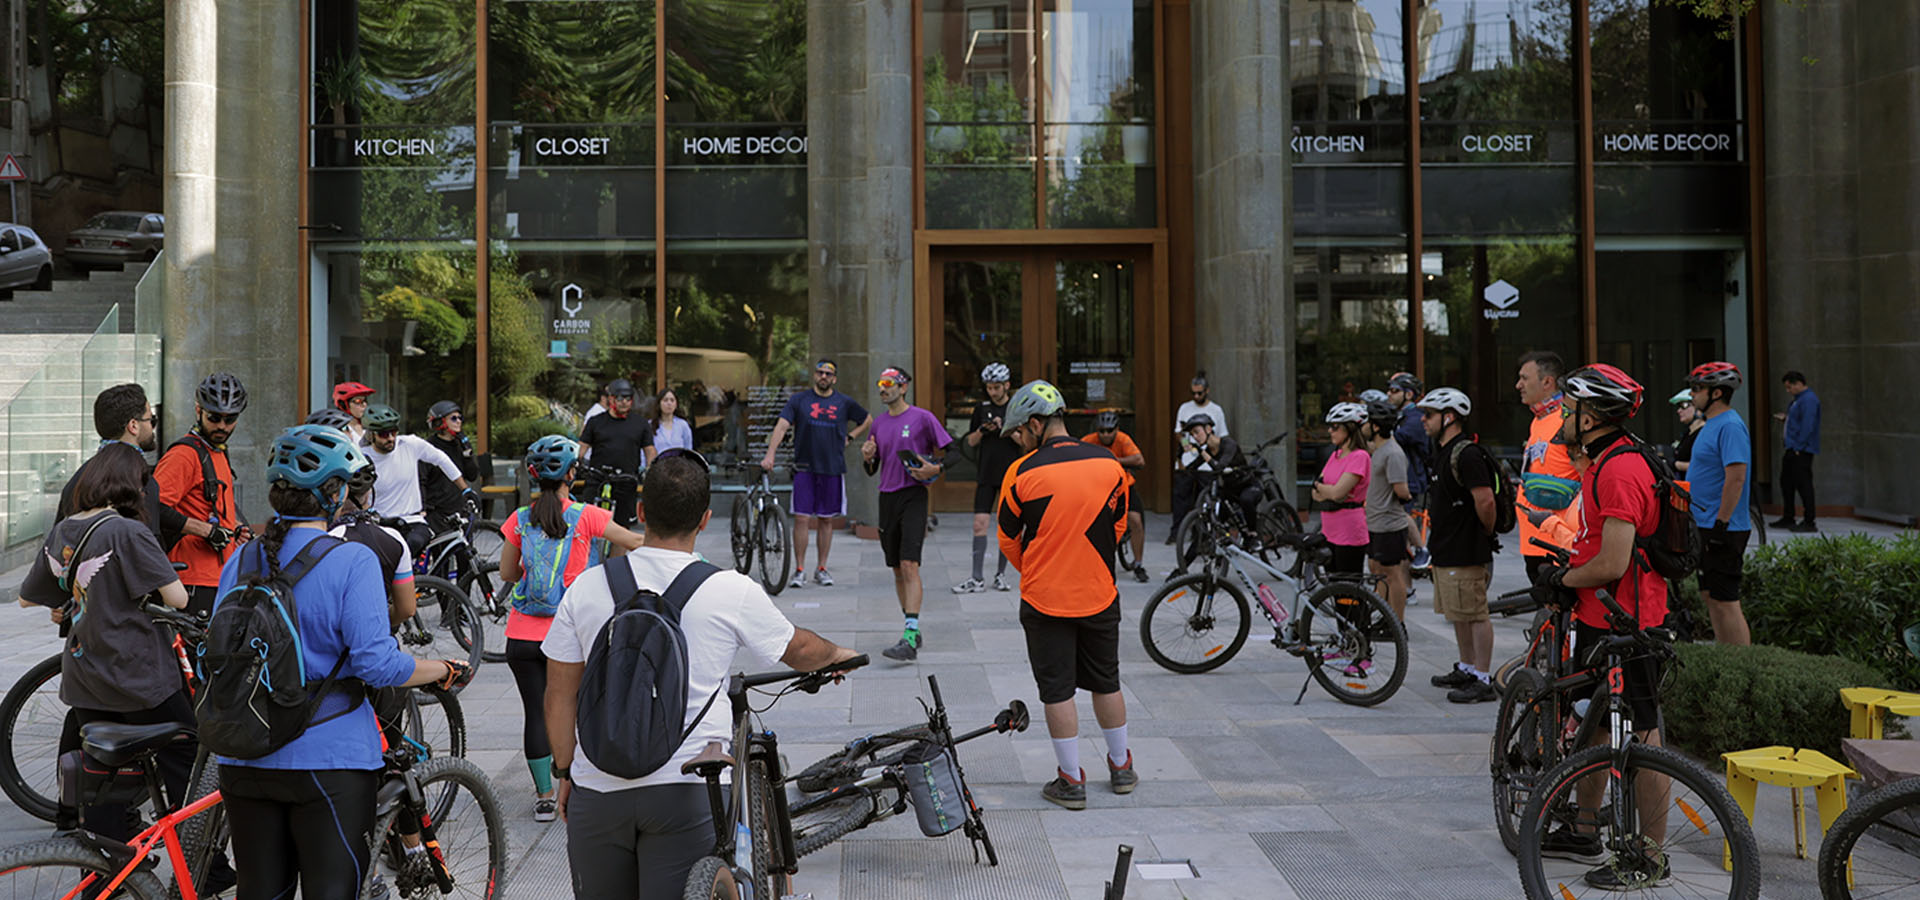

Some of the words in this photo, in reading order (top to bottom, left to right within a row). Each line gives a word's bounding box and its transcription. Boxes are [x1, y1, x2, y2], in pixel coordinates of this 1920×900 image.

[354, 138, 435, 156] KITCHEN
[535, 137, 610, 155] CLOSET
[683, 136, 741, 155] HOME
[1461, 134, 1533, 153] CLOSET
[1603, 134, 1659, 152] HOME
[1663, 134, 1730, 151] DECOR
[553, 319, 590, 329] CARBON
